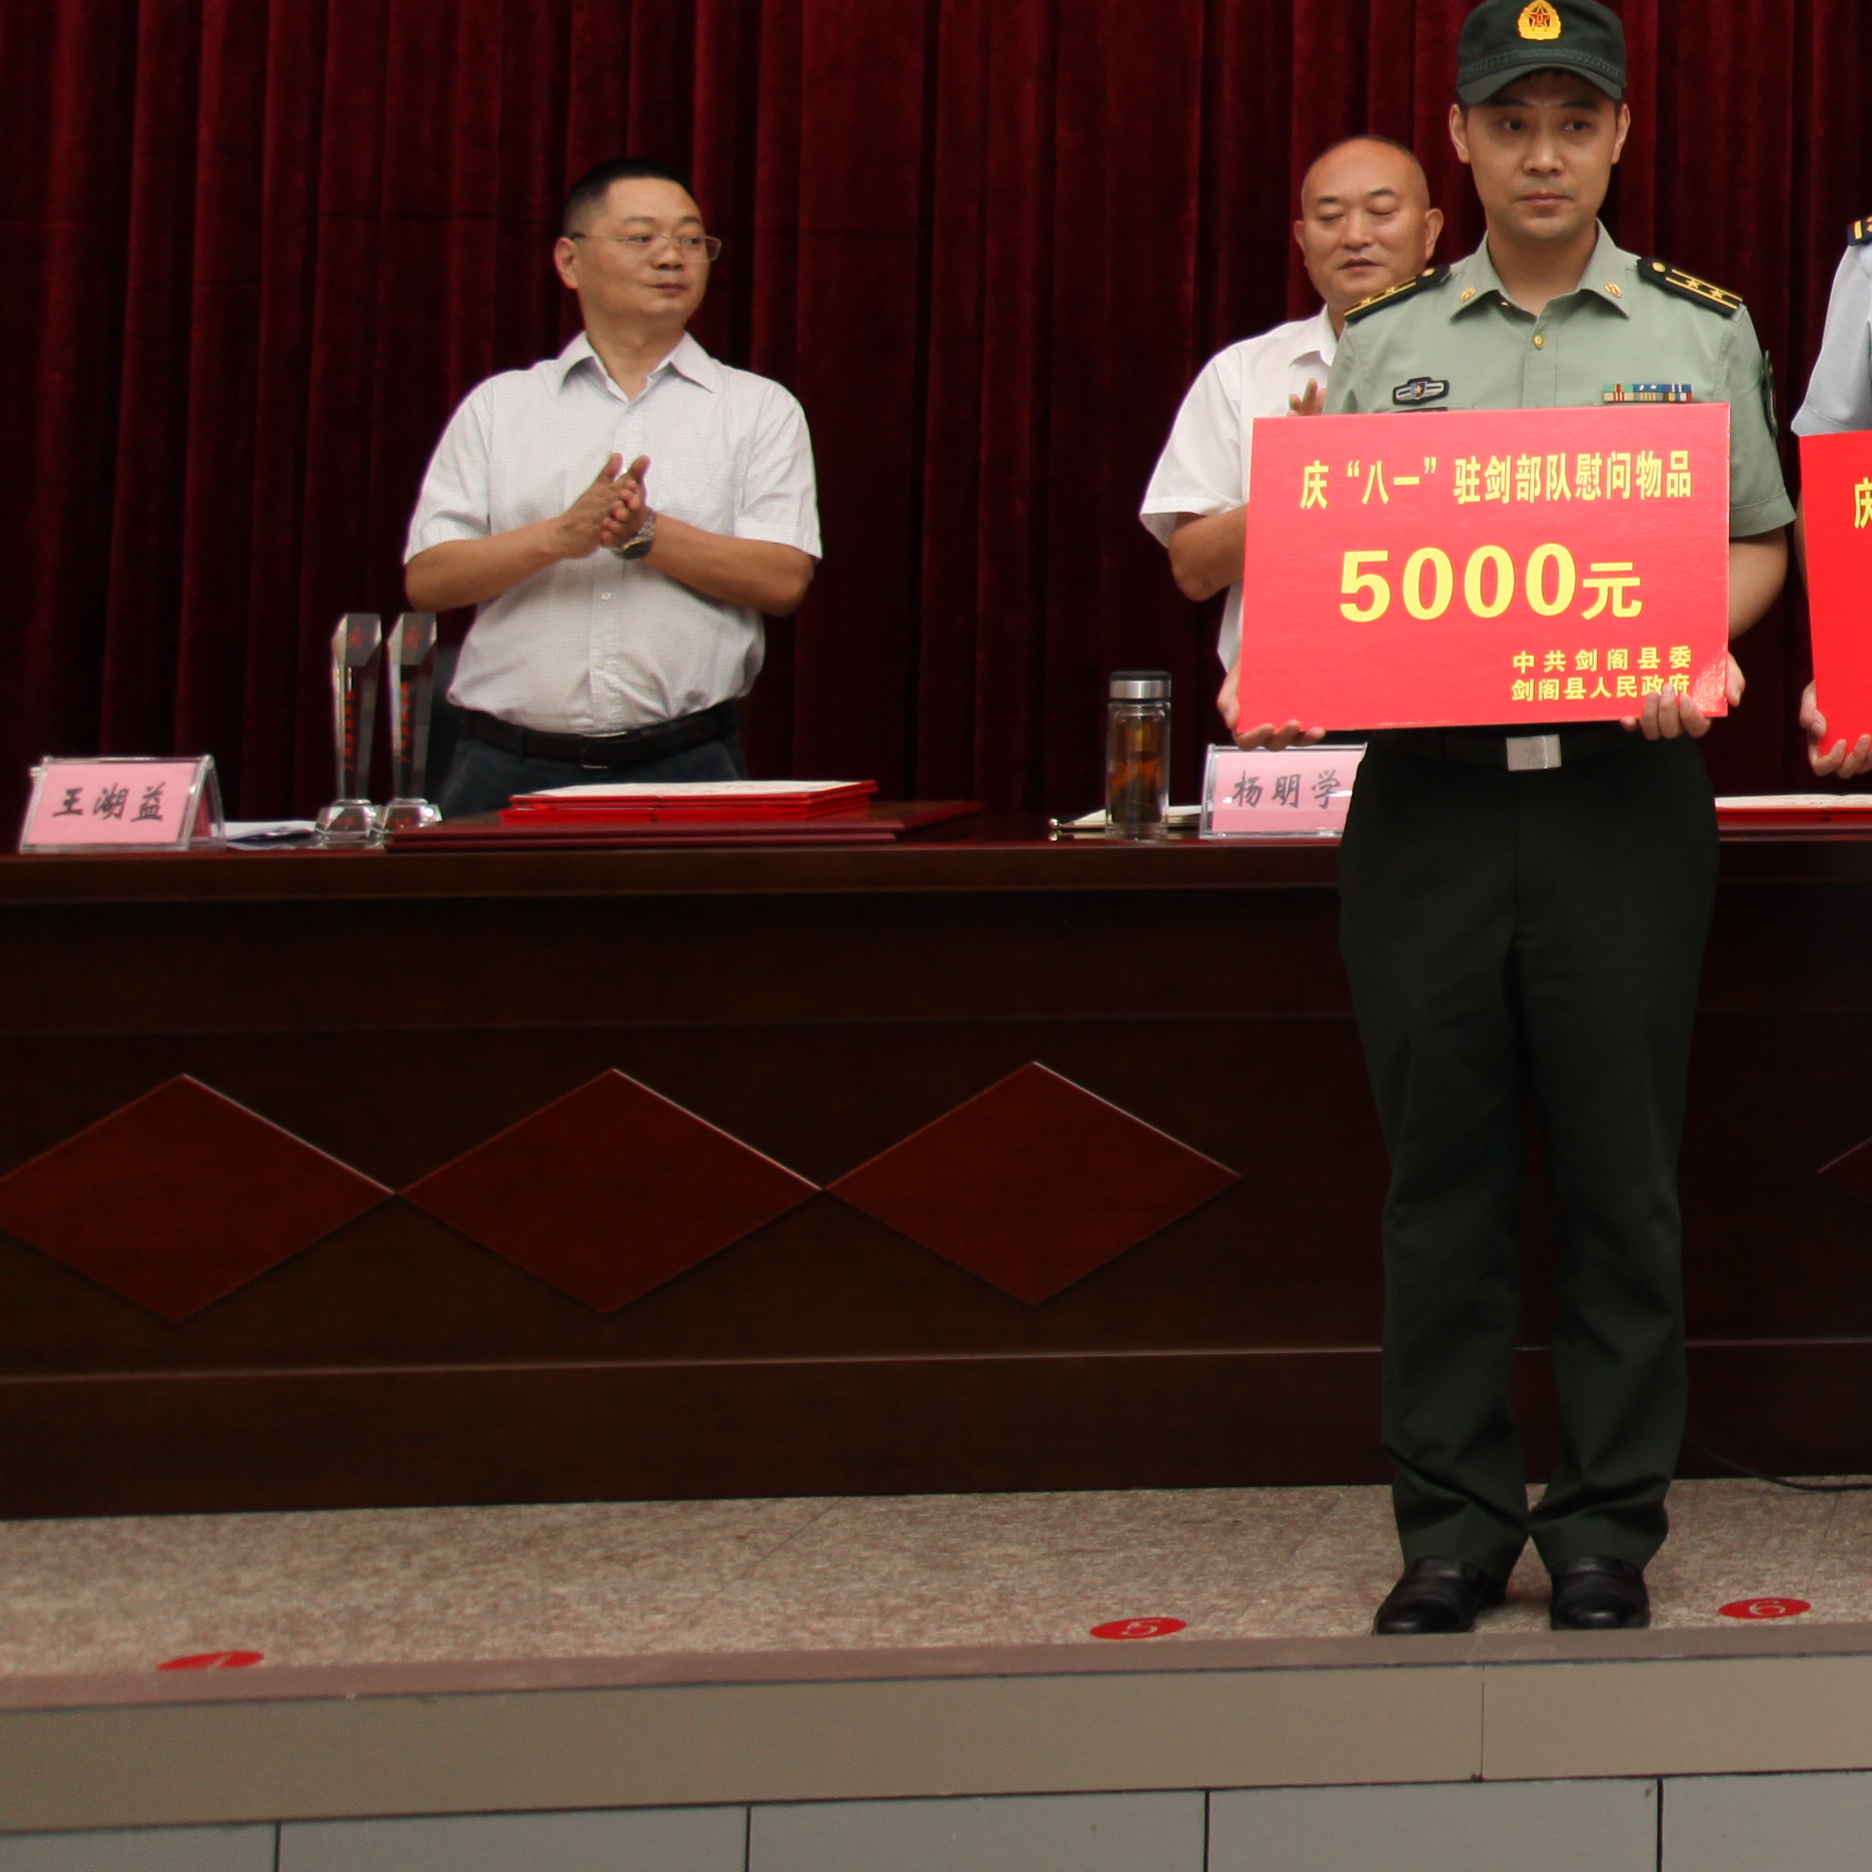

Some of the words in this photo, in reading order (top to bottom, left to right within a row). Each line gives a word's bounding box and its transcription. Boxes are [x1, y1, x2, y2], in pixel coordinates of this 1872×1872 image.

[1340, 543, 1642, 622] 5000元
[1514, 646, 1691, 673] 中共剑阁县委
[1512, 673, 1689, 701] 剑阁县人民政府
[1231, 769, 1342, 810] 杨明学
[1748, 1599, 1787, 1617] 6
[1120, 1618, 1161, 1638] 5
